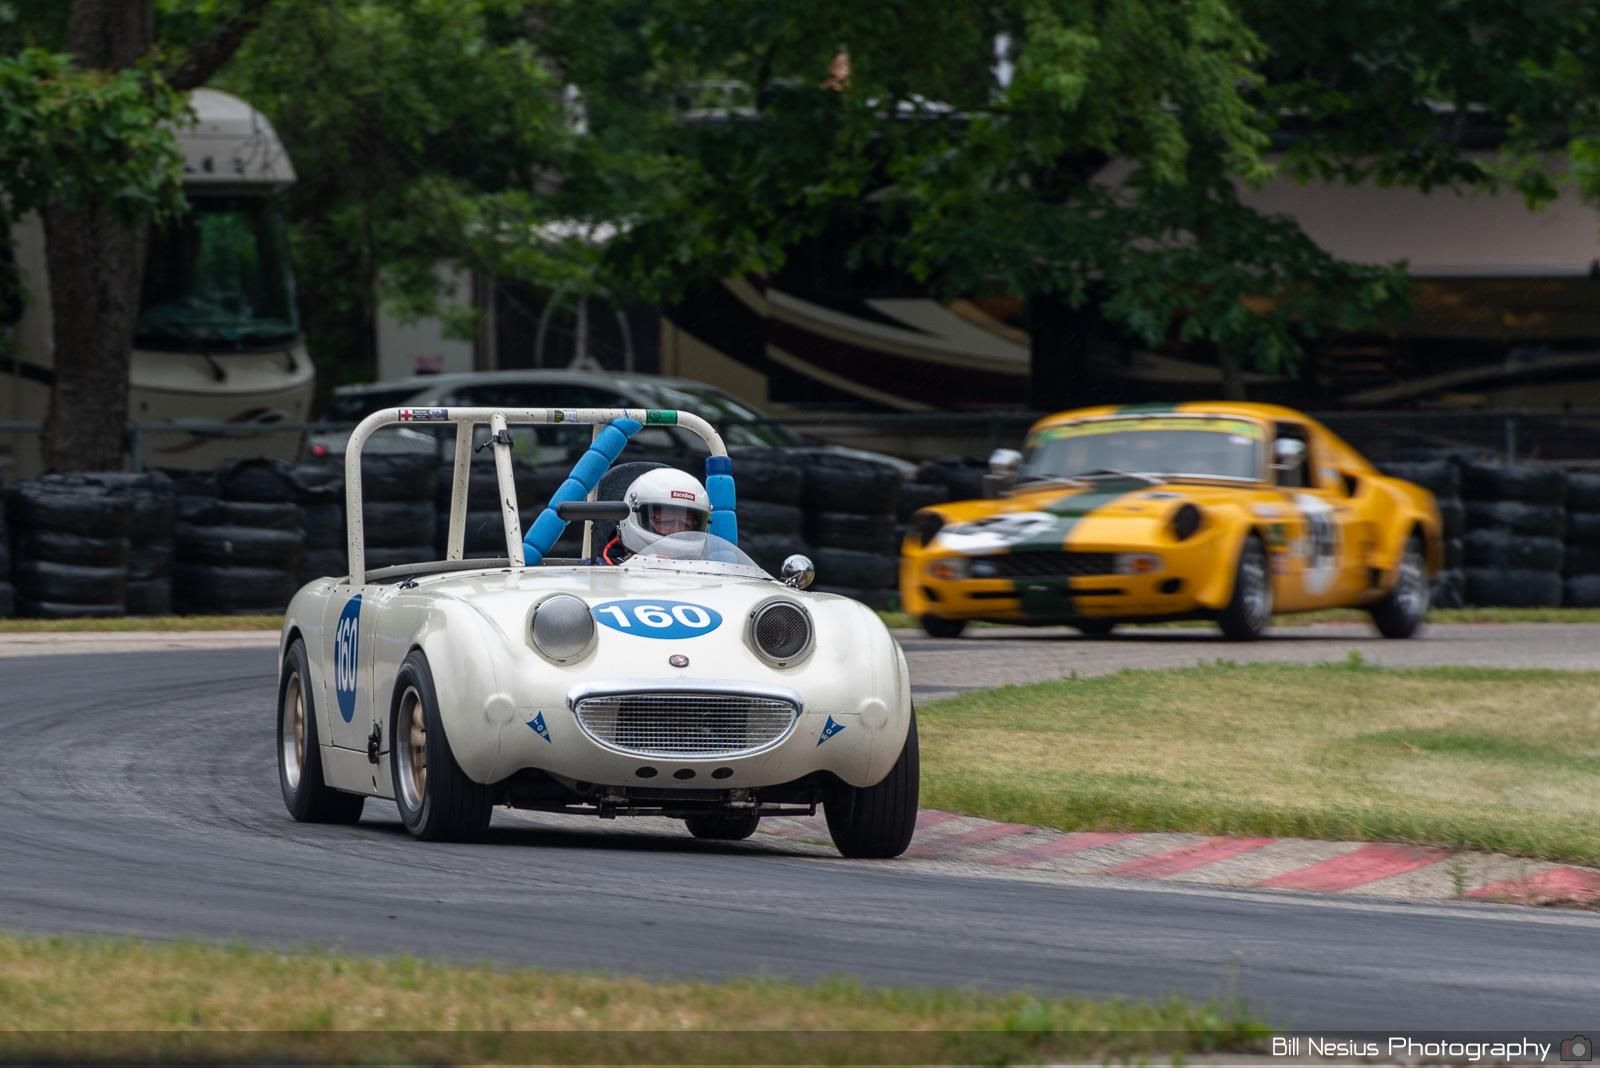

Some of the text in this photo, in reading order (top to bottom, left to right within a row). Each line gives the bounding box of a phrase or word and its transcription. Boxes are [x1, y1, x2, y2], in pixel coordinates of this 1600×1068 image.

[598, 605, 711, 628] 160
[336, 617, 358, 692] 160
[533, 718, 548, 737] TOW
[821, 717, 837, 735] TOW
